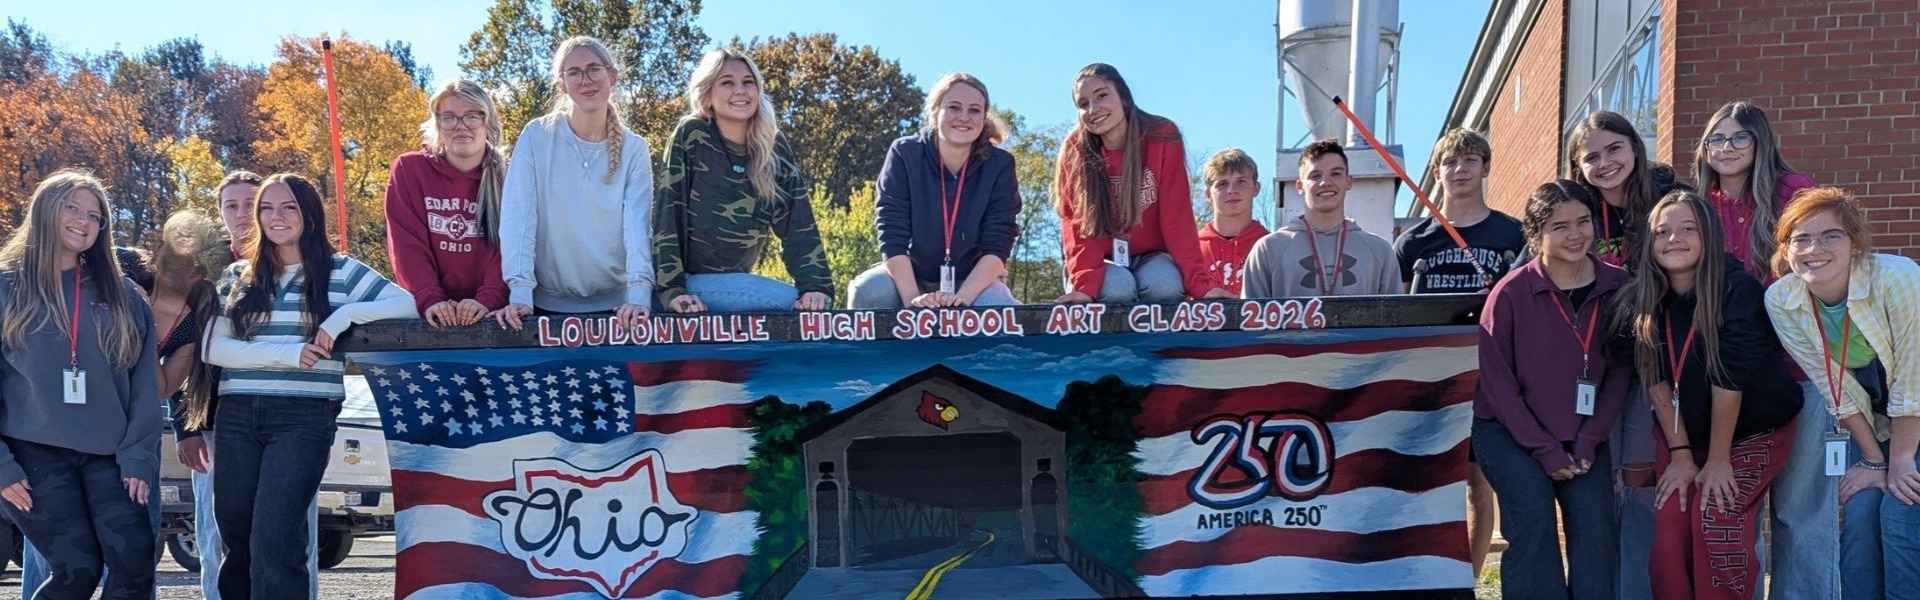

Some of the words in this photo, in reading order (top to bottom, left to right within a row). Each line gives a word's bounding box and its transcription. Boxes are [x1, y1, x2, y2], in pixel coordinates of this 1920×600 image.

[424, 196, 460, 211] EDAR
[449, 220, 465, 233] CP
[439, 240, 472, 252] OHIO
[1424, 246, 1503, 274] OUGHHOUSE
[538, 313, 770, 348] LOUDONVILLE
[800, 311, 876, 340] HIGH
[893, 307, 1024, 339] SCHOOL
[1046, 303, 1106, 335] ART
[1128, 302, 1226, 332] CLASS
[1240, 297, 1327, 331] 2026
[1186, 409, 1336, 510] 250
[491, 488, 691, 560] Ohio
[1197, 508, 1274, 530] AMERICA
